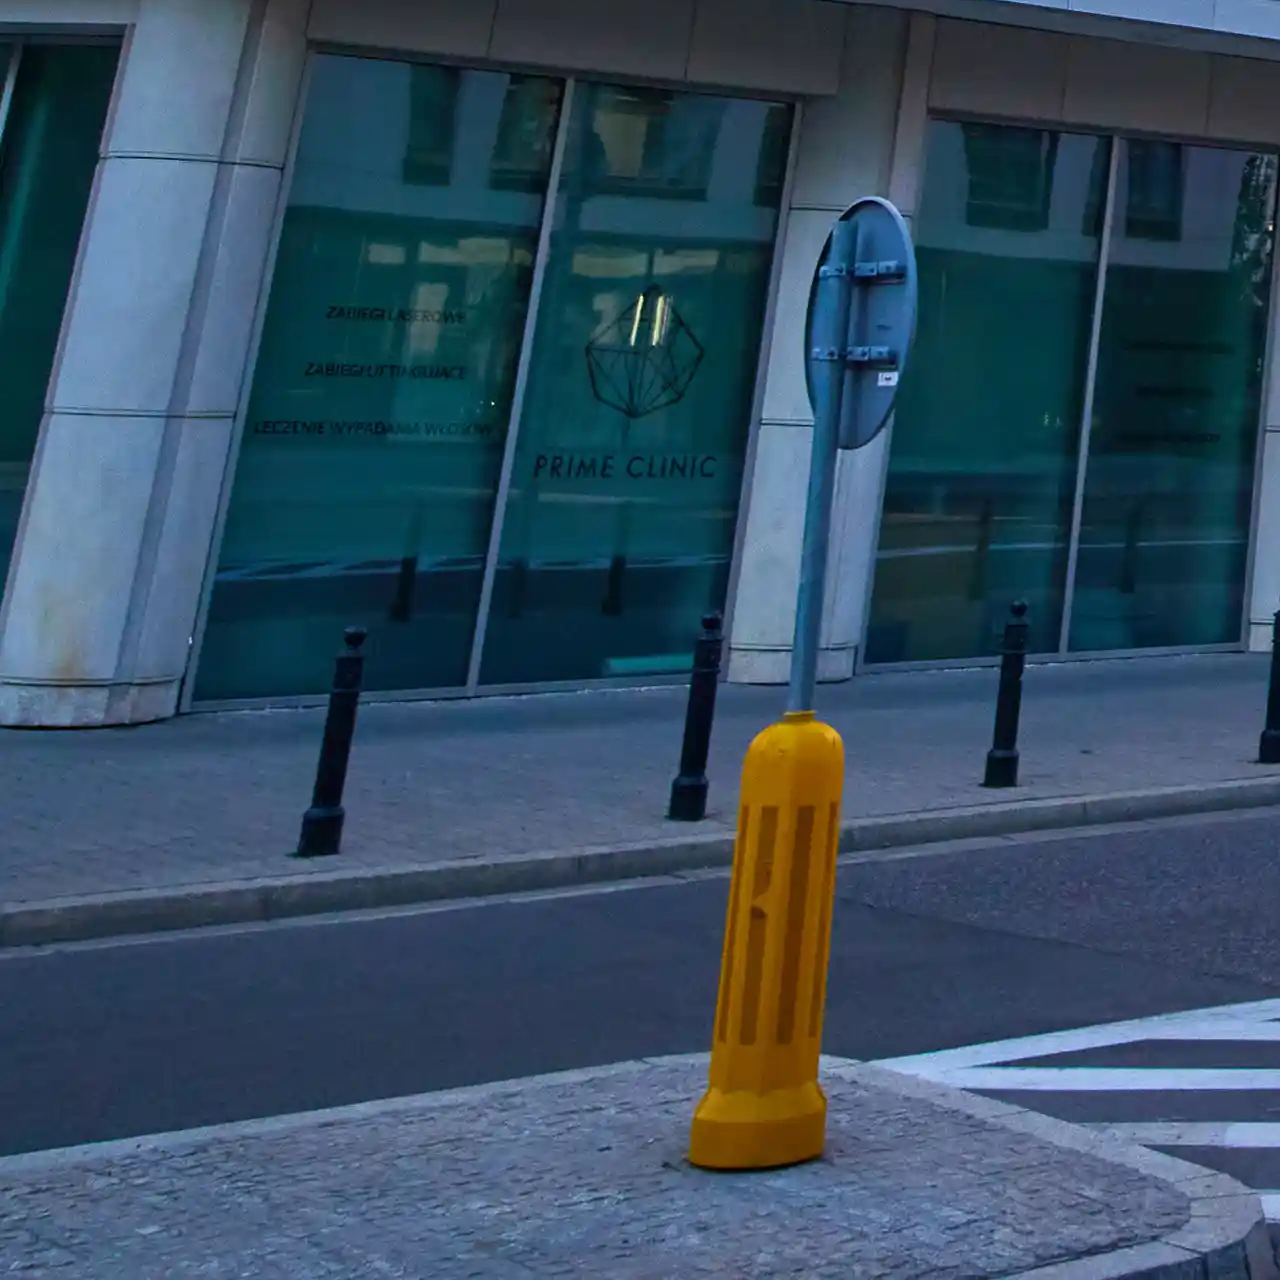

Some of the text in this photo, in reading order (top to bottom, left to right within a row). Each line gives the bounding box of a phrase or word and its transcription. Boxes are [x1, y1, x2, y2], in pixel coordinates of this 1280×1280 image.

[304, 362, 363, 378] ZABIEGI
[254, 421, 325, 436] LECZENIE
[534, 454, 717, 479] PRIME CLINIC
